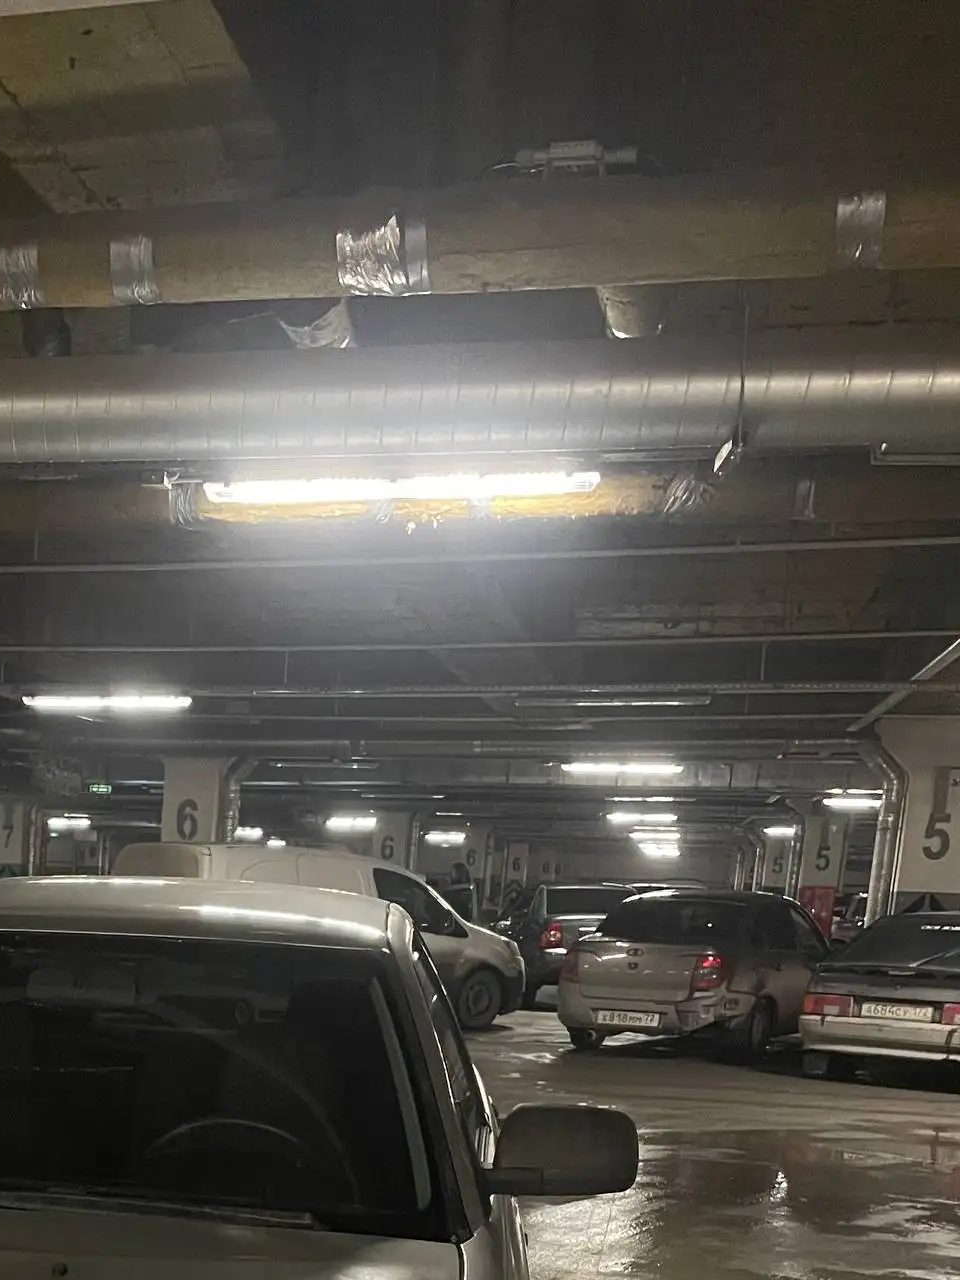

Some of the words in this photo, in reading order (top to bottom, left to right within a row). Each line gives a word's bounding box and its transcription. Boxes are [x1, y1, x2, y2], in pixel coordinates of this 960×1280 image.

[176, 798, 199, 841] 6
[2, 825, 13, 848] 7
[381, 836, 394, 860] 6
[922, 813, 951, 861] 5
[466, 849, 476, 866] 6
[512, 857, 521, 872] 6
[772, 857, 784, 873] 5
[815, 845, 831, 871] 5
